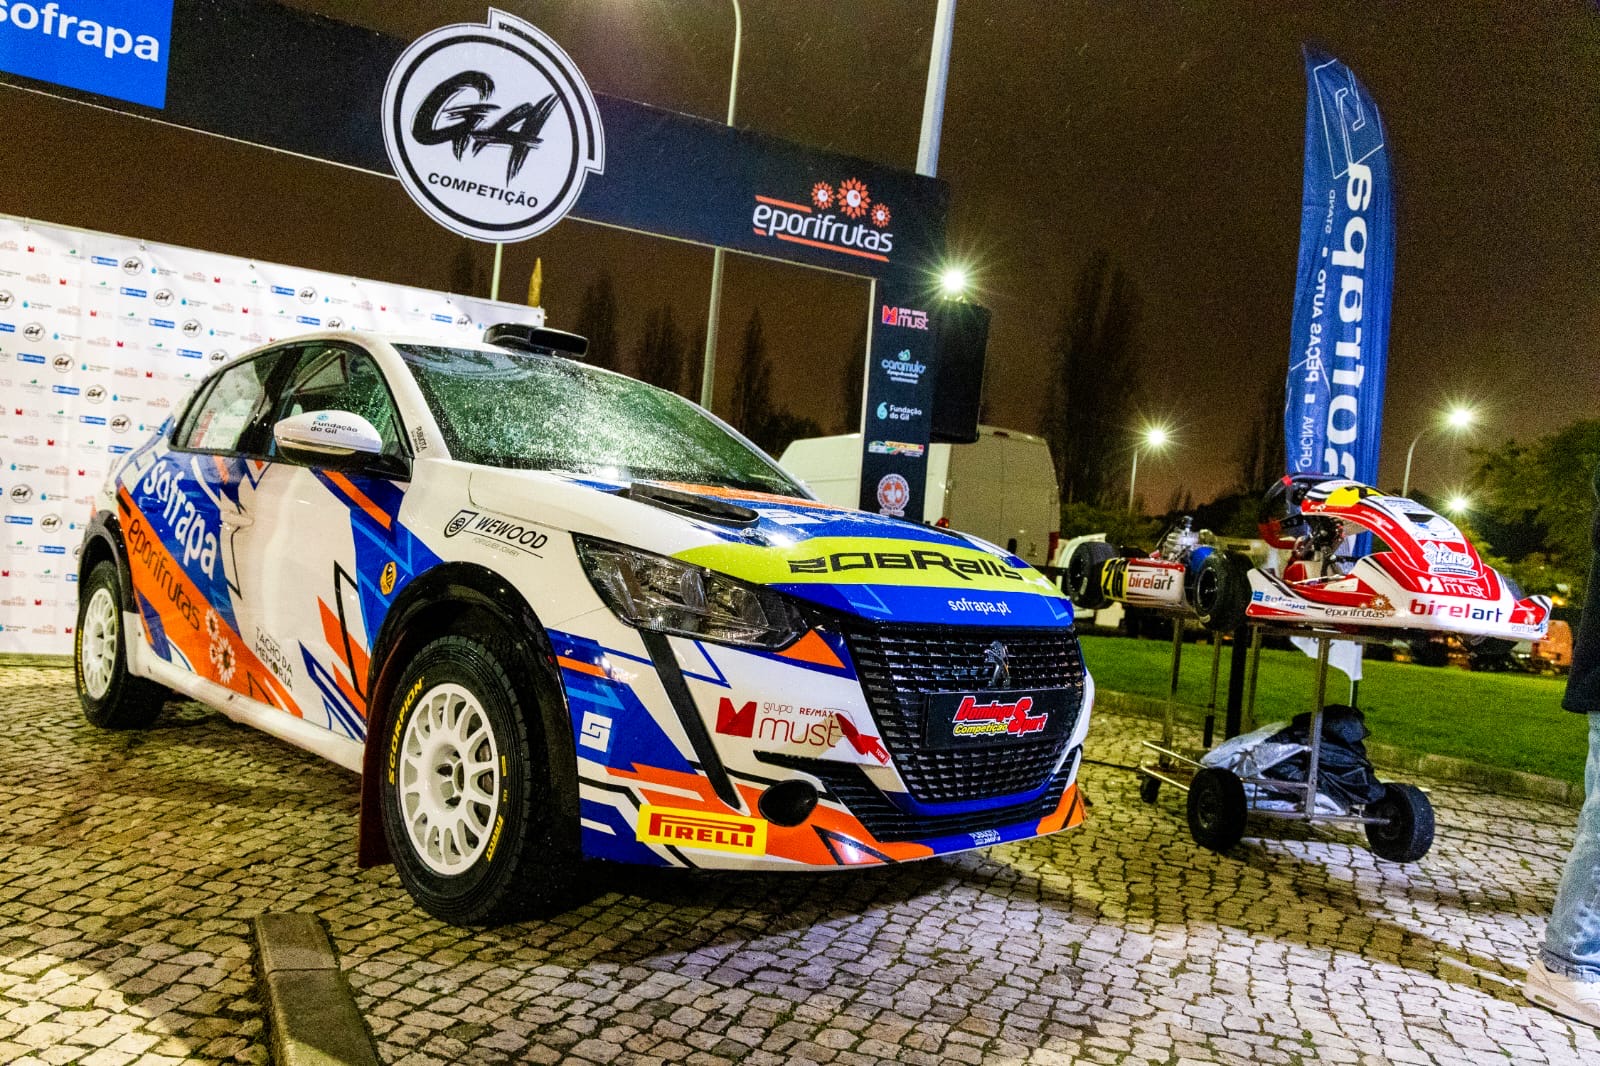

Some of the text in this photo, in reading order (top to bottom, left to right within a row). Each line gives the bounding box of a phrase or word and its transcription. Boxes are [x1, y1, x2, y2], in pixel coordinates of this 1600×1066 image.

[428, 172, 538, 208] COMPETIÇÃO
[752, 203, 894, 253] eporifrutas
[898, 315, 929, 330] must
[881, 359, 926, 374] caramulo
[889, 404, 922, 416] Fundação
[900, 412, 910, 421] Gil
[312, 420, 358, 433] Fundação
[324, 427, 338, 435] Gil
[142, 459, 217, 580] sofrapa
[475, 516, 548, 549] WEWOOD
[128, 519, 200, 631] eporifrutas
[1128, 573, 1175, 591] birelart
[1444, 583, 1488, 599] must
[948, 597, 1012, 614] sofrapa.pt
[1325, 607, 1385, 618] eporifrutas
[1410, 599, 1504, 623] birelart
[256, 626, 281, 662] TACHO
[282, 655, 293, 677] DA
[763, 702, 834, 718] grupo RE/MAX
[388, 676, 424, 785] SCORPION
[758, 717, 841, 748] must
[953, 722, 1008, 737] Competição
[649, 813, 755, 847] PIRELLI
